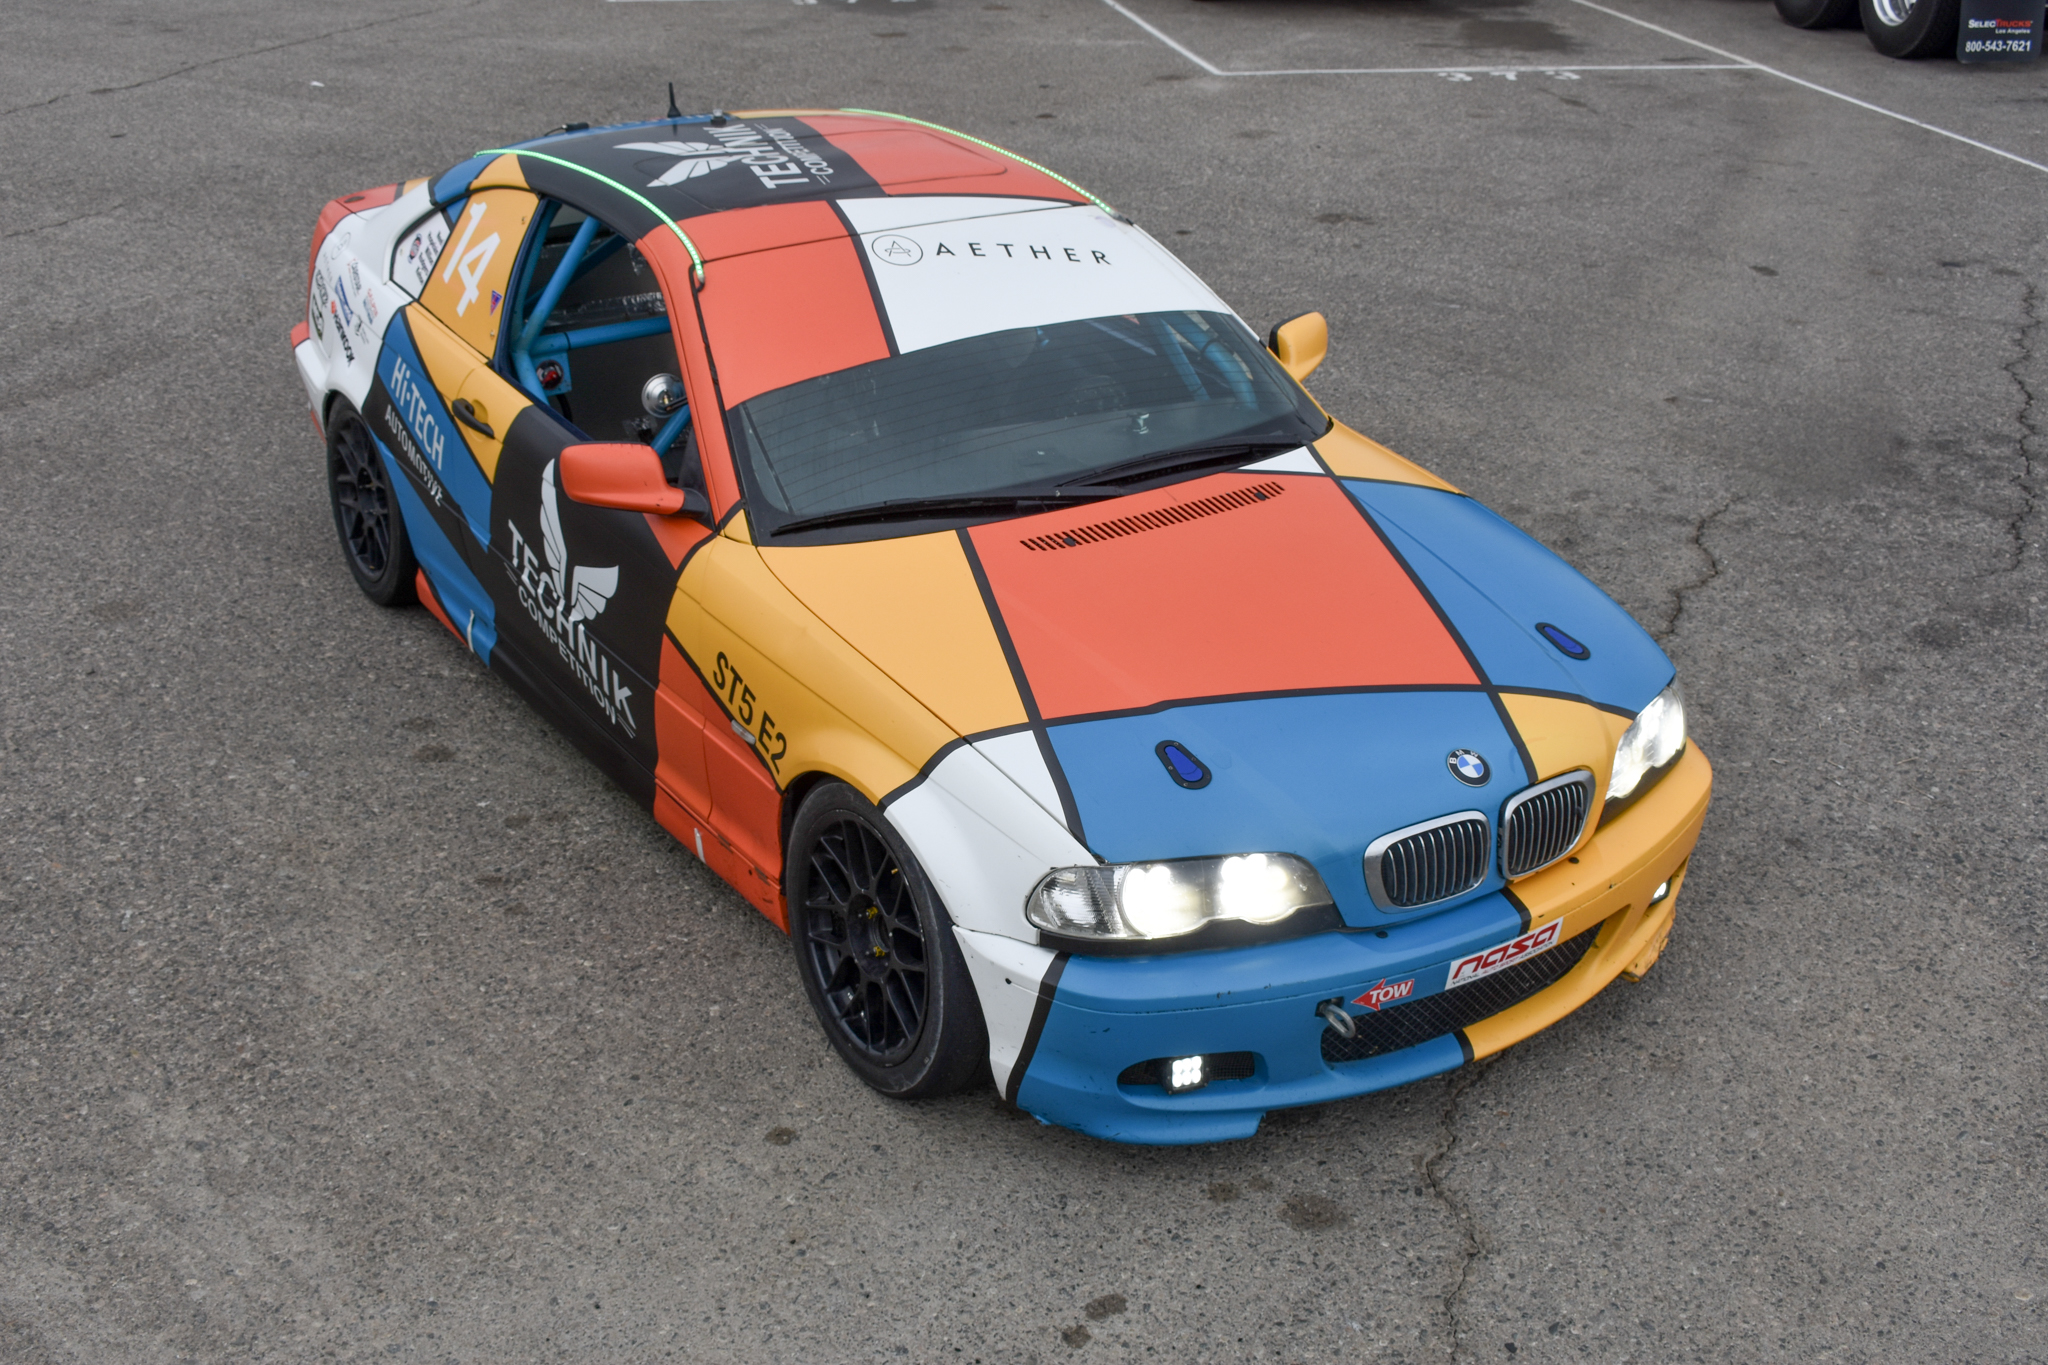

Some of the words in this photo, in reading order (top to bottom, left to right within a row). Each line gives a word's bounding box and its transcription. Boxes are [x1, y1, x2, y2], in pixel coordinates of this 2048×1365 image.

[1965, 40, 2031, 53] 800-543-7621
[703, 123, 810, 189] TECHNIK
[442, 202, 500, 317] 14
[936, 242, 1112, 265] AETHER
[384, 404, 444, 507] AUTOMOTIVE
[507, 519, 637, 730] TECHNIK
[518, 584, 617, 725] COMPETITION
[712, 651, 757, 726] ST5
[758, 710, 788, 776] E2
[1369, 981, 1412, 1005] TOW
